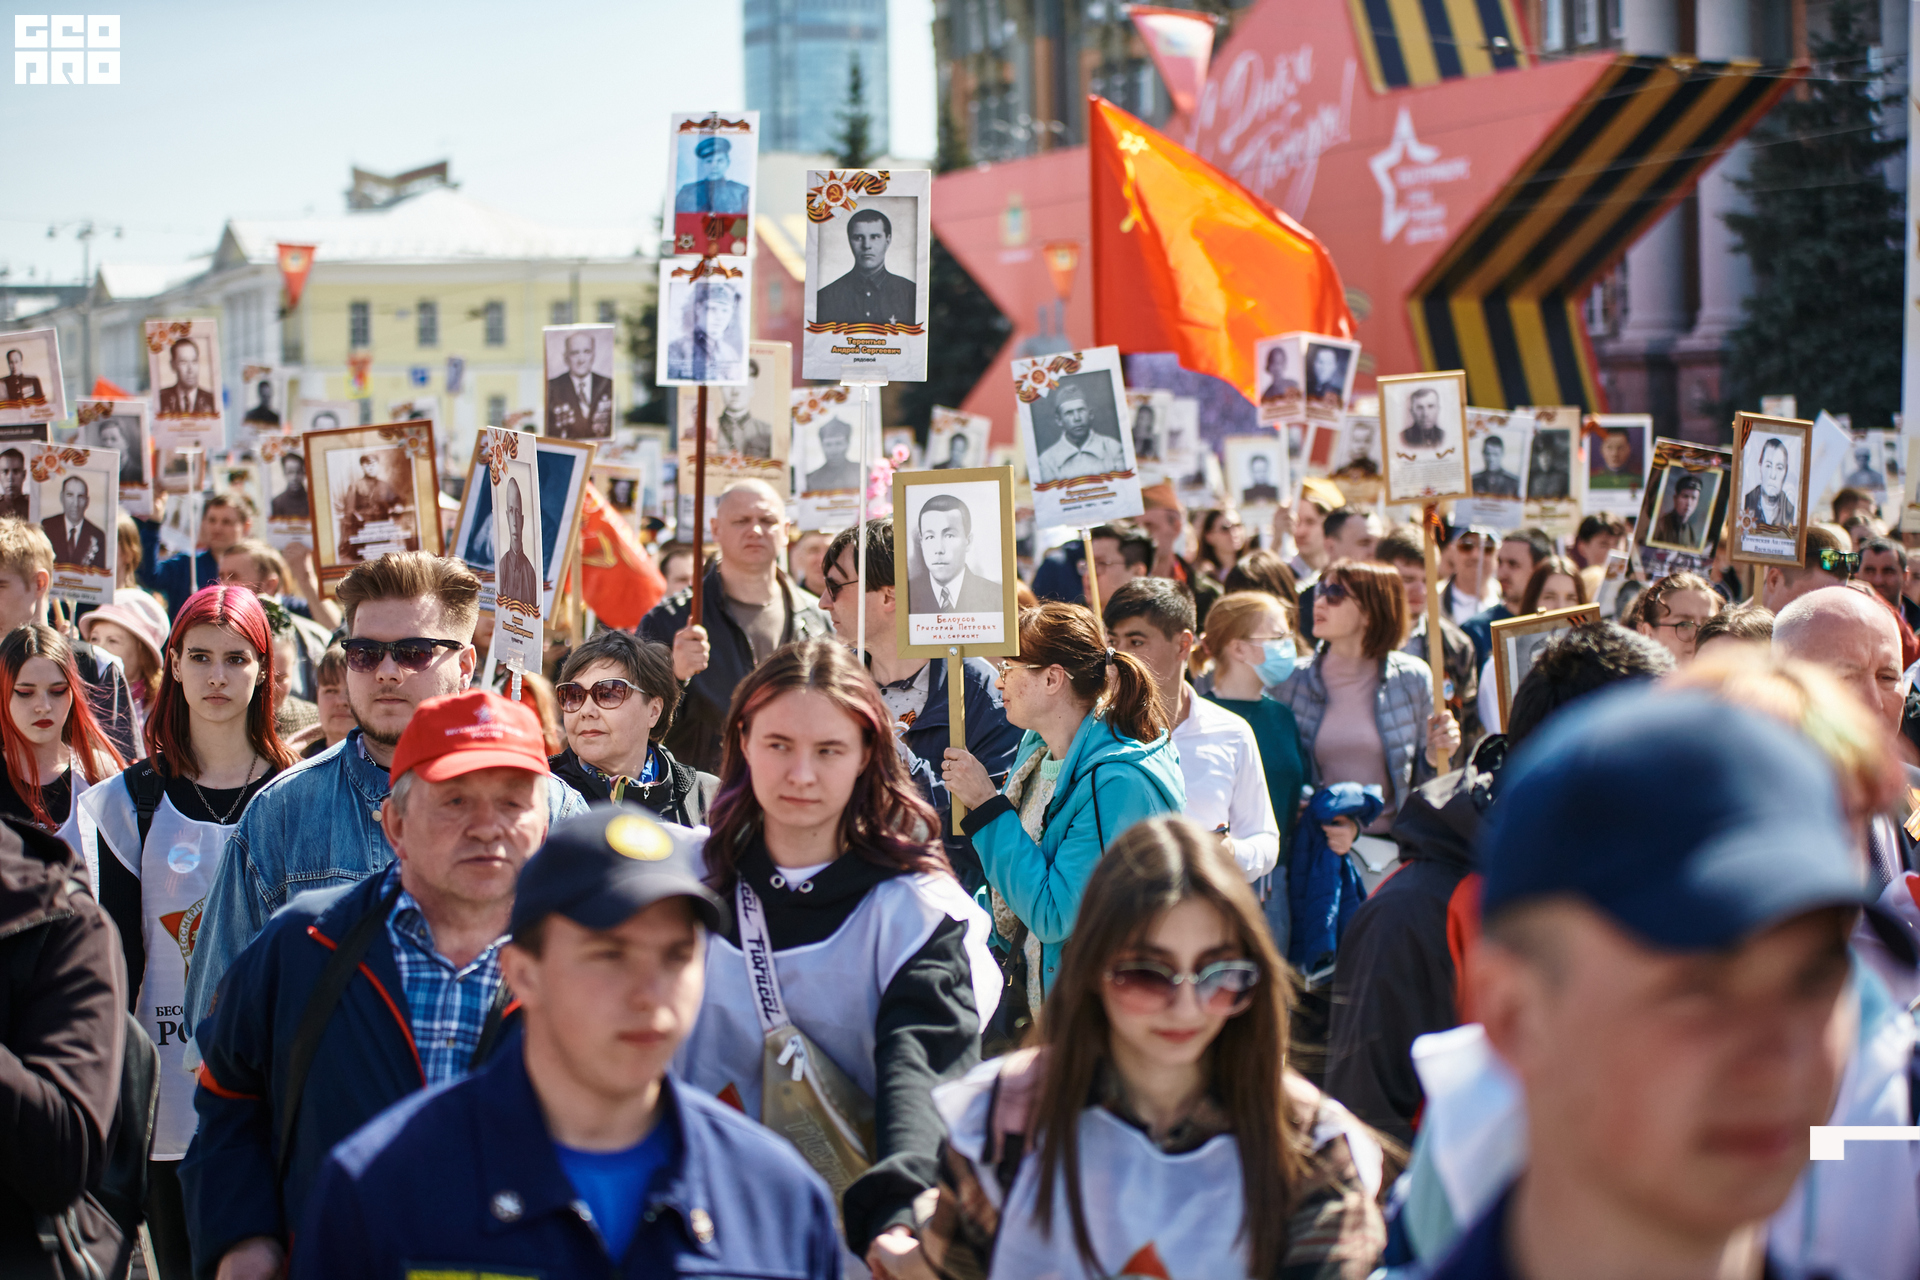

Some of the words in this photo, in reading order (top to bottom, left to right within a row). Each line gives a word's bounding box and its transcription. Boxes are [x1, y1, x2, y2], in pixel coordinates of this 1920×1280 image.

[847, 337, 886, 345] Терентьев
[831, 346, 860, 355] Андрей
[861, 347, 901, 355] Сергеевич
[936, 614, 975, 624] Белоусов
[916, 624, 953, 632] Григорий
[958, 623, 997, 631] Петрович
[747, 926, 781, 1027] Fiorucci
